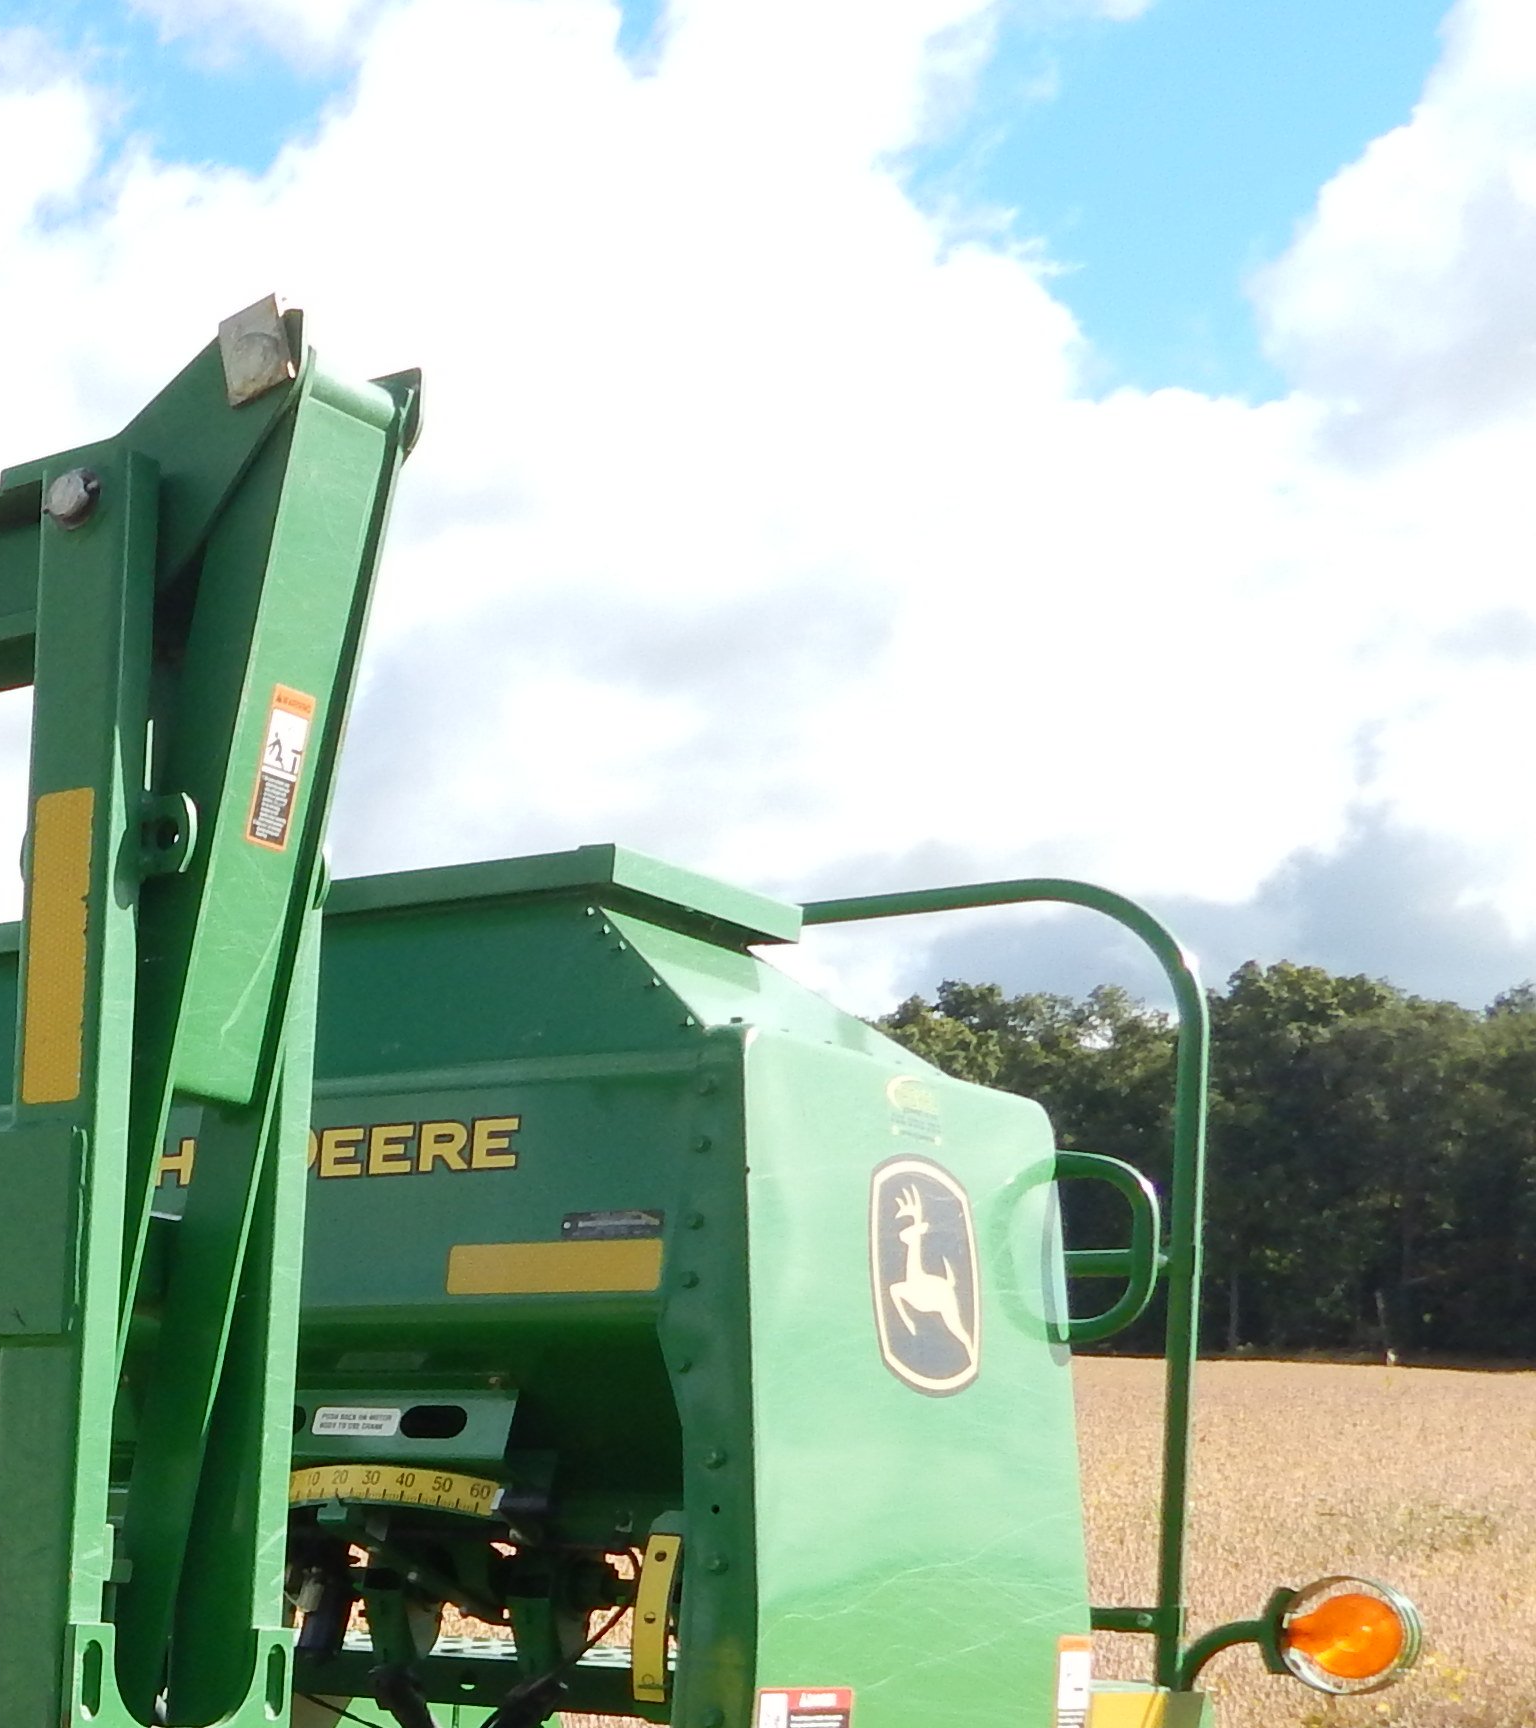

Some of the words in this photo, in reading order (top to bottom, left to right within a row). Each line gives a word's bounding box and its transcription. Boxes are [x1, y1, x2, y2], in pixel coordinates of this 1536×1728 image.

[308, 1115, 521, 1179] EERE
[307, 1471, 321, 1486] 10
[331, 1469, 349, 1485] 20
[361, 1470, 381, 1485] 30
[395, 1472, 416, 1488] 40
[431, 1476, 453, 1493] 50
[469, 1483, 491, 1500] 60
